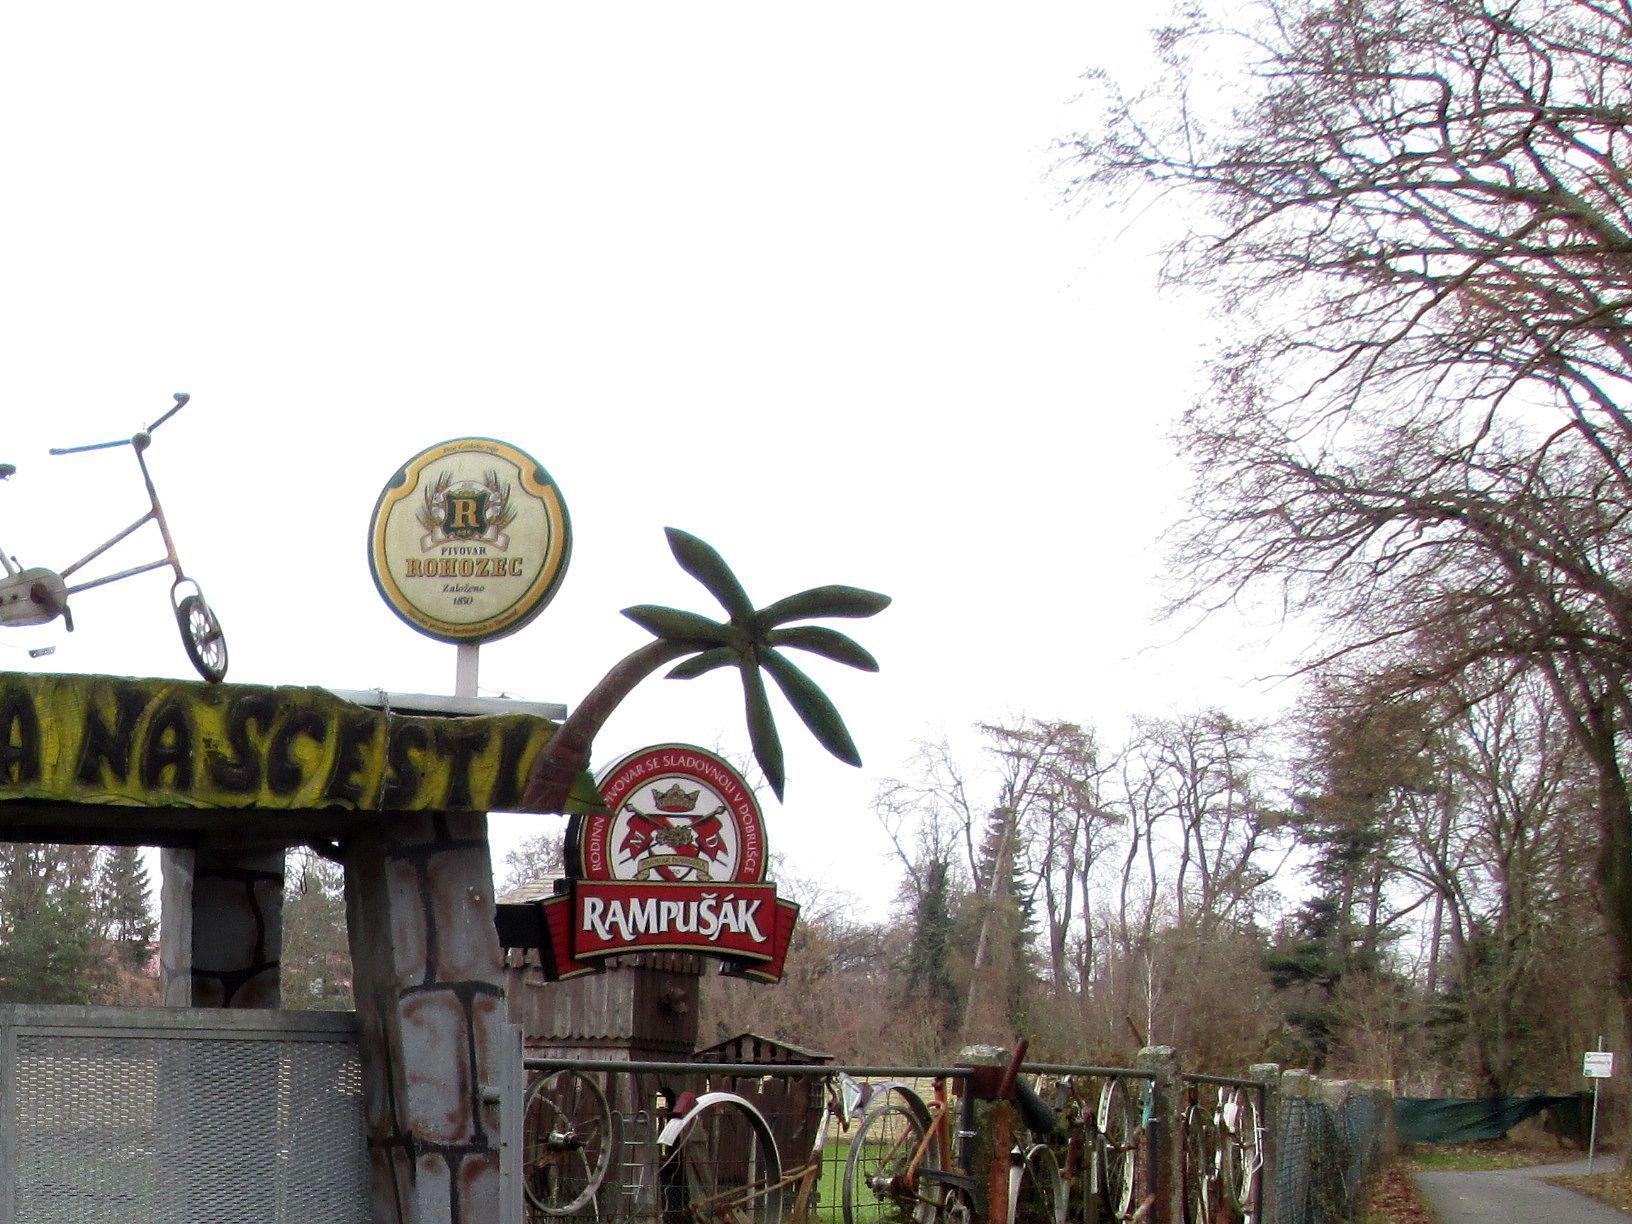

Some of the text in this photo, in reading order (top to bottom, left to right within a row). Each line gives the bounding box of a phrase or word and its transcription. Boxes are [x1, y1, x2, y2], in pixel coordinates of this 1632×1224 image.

[451, 498, 479, 528] R
[441, 546, 487, 556] PIVOVAR
[405, 557, 524, 578] ROHOZEC
[76, 689, 195, 792] NA
[591, 815, 606, 872] RODINN
[645, 758, 661, 772] SE
[663, 755, 737, 794] SLADOVNOU
[734, 793, 744, 802] V
[705, 834, 719, 848] D
[582, 892, 768, 943] RAMPUŠÁK
